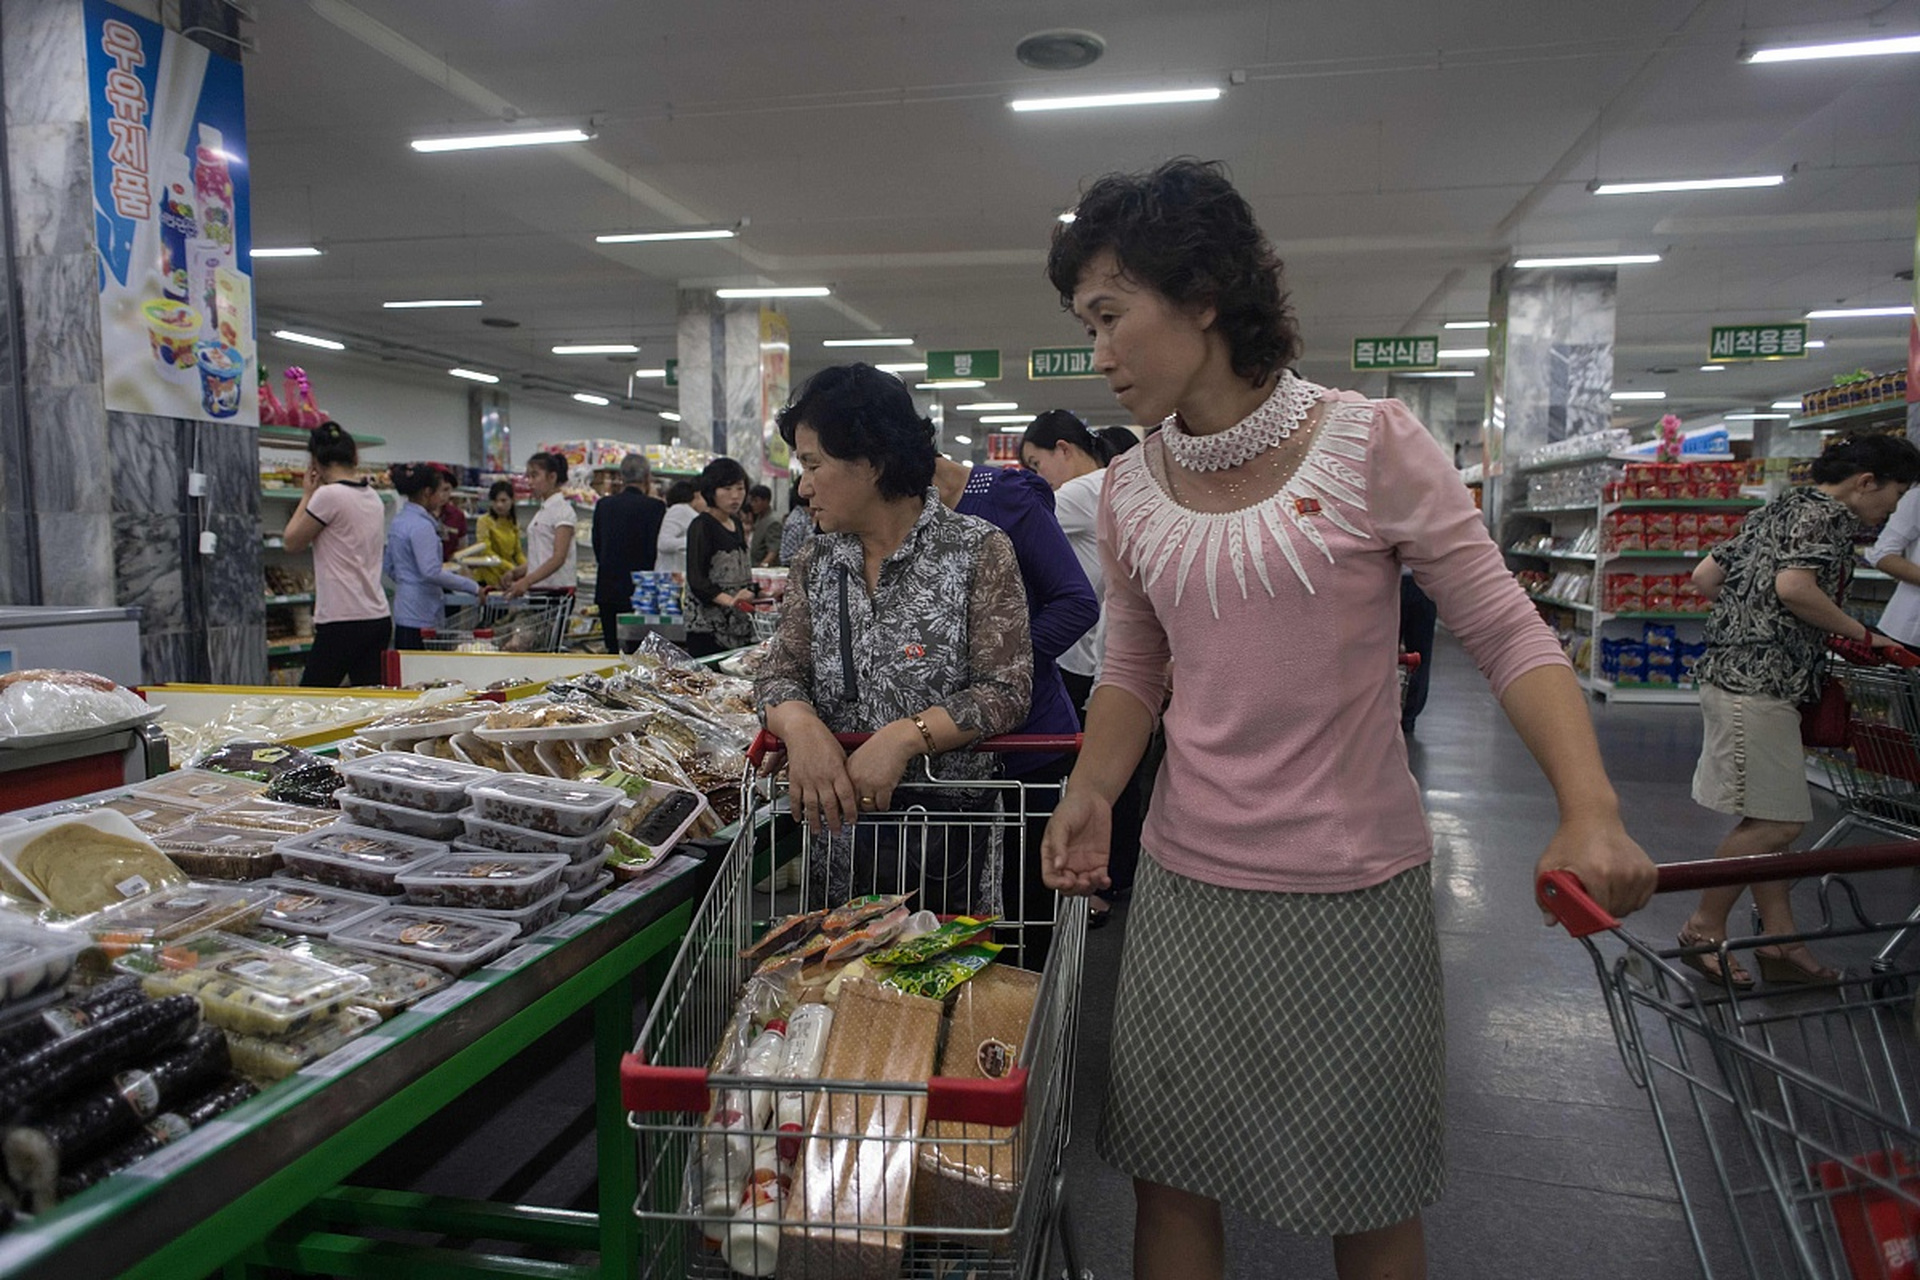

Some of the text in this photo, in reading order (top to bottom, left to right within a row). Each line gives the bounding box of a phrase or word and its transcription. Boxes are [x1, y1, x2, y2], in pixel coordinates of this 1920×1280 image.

[102, 19, 151, 220] 우유제품
[1357, 341, 1434, 364] 즉석식품
[1713, 329, 1802, 354] 세척용품
[954, 353, 973, 376] 빵
